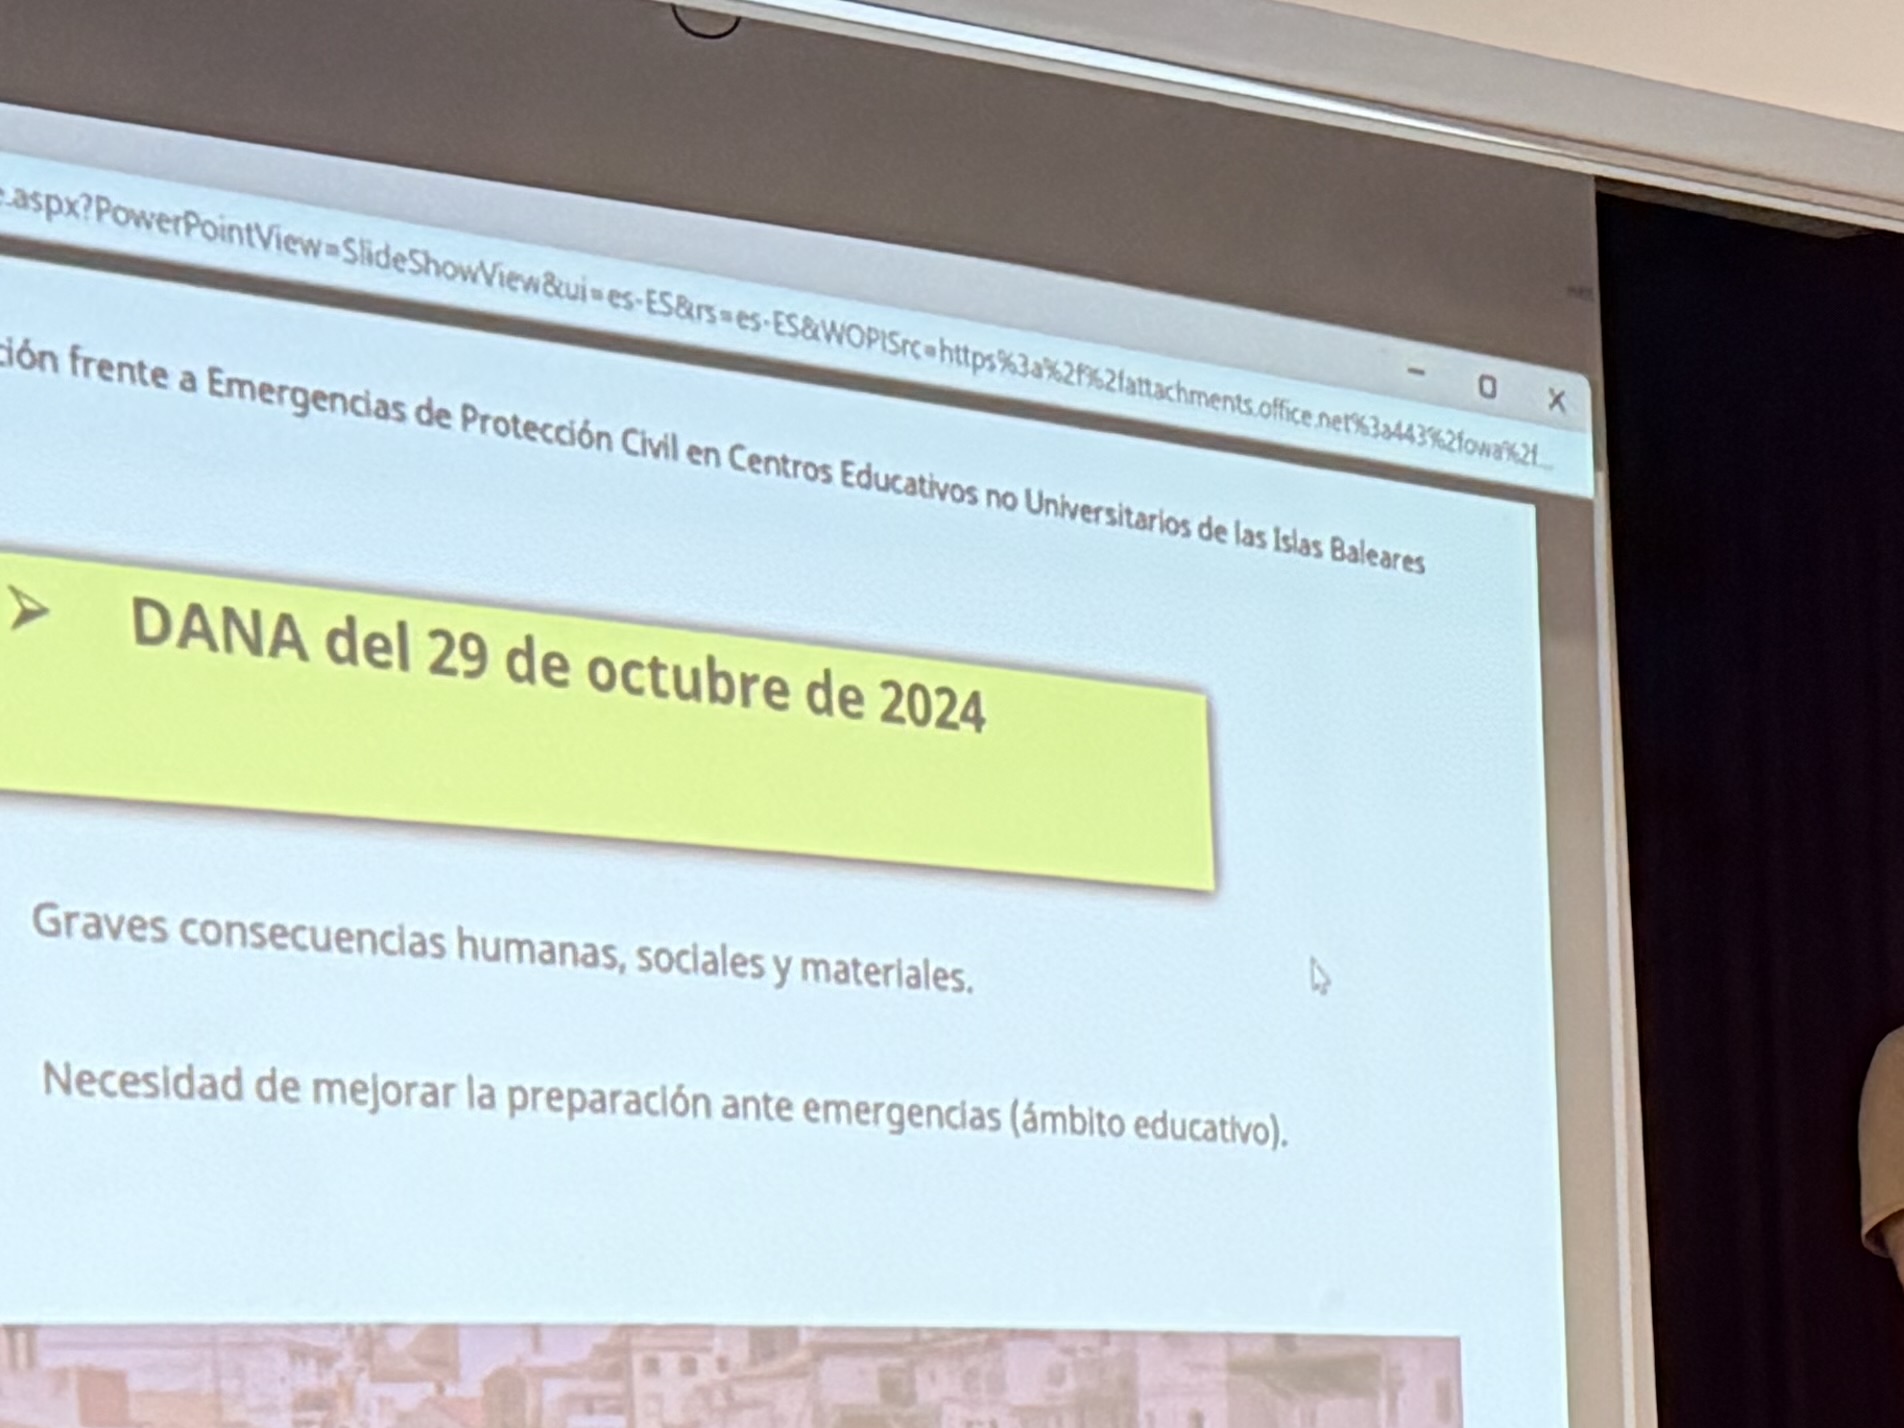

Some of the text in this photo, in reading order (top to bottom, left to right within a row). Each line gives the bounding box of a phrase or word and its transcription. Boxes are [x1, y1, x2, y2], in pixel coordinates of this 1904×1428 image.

[69, 343, 169, 390] frente
[179, 370, 198, 393] a
[207, 365, 407, 423] Emergencias
[414, 396, 452, 430] de
[461, 402, 613, 452] Protección
[621, 427, 679, 462] Civil
[685, 444, 722, 468] en
[728, 443, 833, 485] Centros
[840, 459, 979, 506] Educativos
[986, 488, 1019, 512] no
[1024, 487, 1192, 539] Universitarios
[1197, 515, 1228, 545] de
[1234, 519, 1268, 550] las
[1273, 525, 1324, 559] Islas
[1330, 535, 1426, 575] Baleares
[132, 596, 987, 734] DANA del 29 de octubre de 2024
[32, 901, 974, 994] Graves consecuencias humanas, sociales y materiales.
[43, 1060, 1289, 1152] Necesidad de mejorar la preparación ante emergencias (ámbito educativo).
